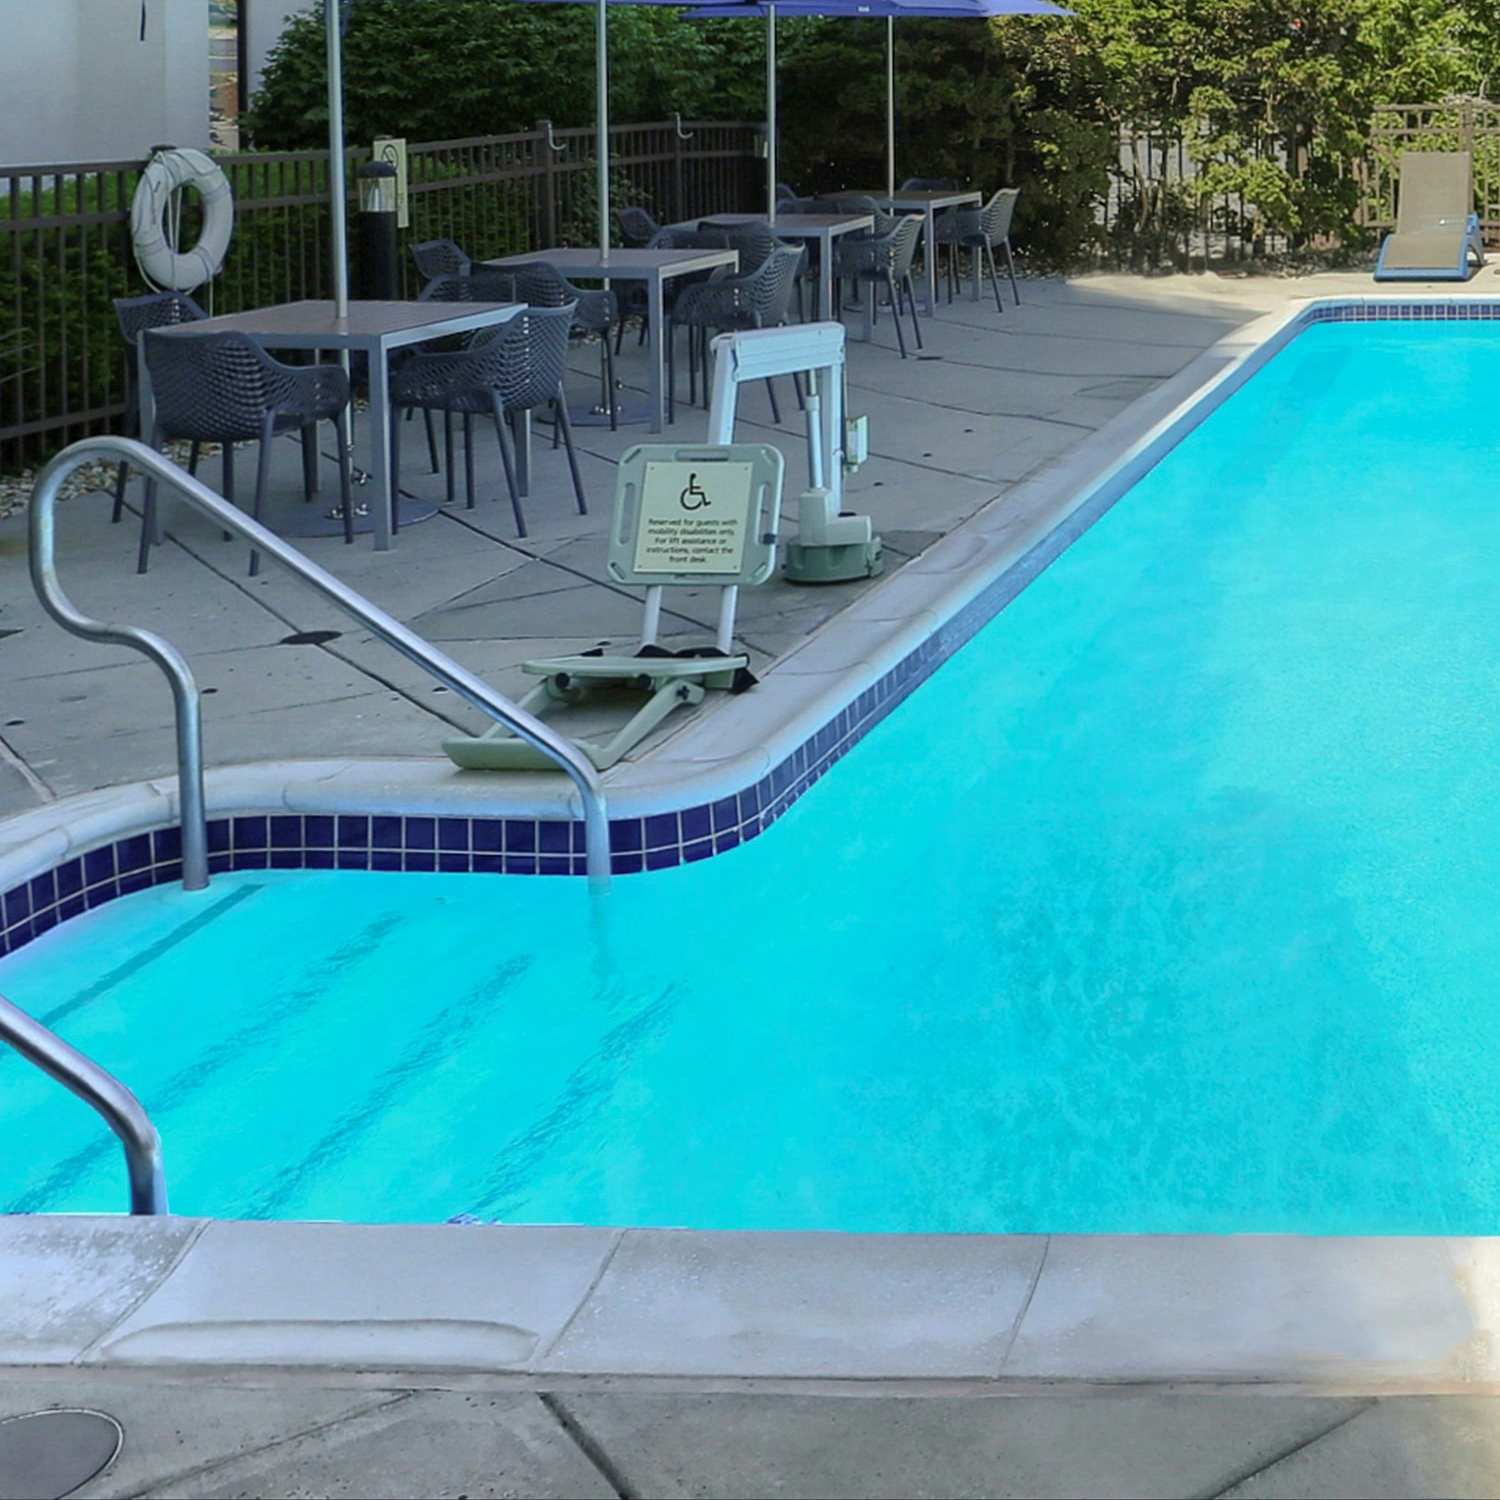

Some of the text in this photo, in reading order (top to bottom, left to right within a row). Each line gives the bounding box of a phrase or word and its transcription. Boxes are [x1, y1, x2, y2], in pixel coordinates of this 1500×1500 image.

[649, 518, 738, 528] Reserved for guests with
[648, 527, 677, 536] mobility
[654, 536, 666, 544] For
[668, 536, 680, 545] lift
[682, 537, 716, 545] assistance
[691, 546, 719, 554] contact
[721, 546, 733, 554] the
[669, 555, 688, 563] front
